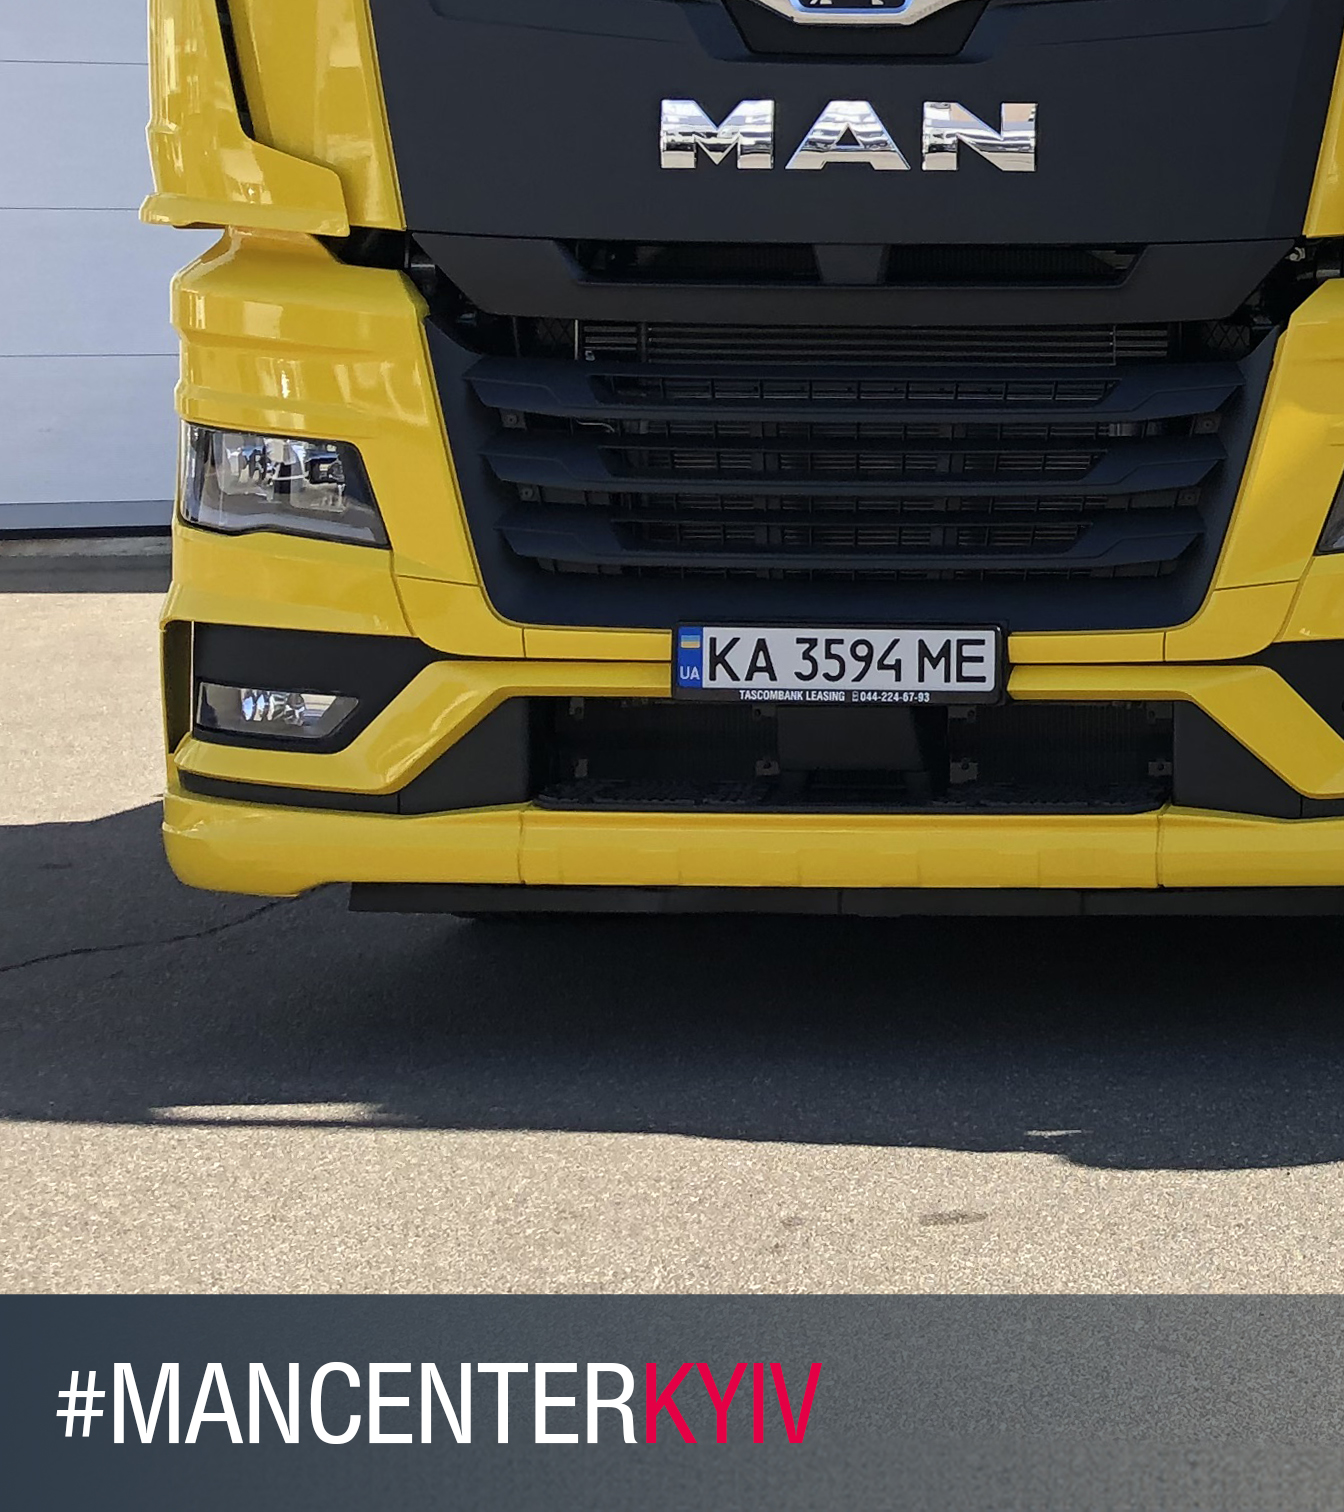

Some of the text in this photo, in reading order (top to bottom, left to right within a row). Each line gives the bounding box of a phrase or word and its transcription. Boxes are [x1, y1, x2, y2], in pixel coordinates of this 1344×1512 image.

[660, 99, 1038, 172] MAN
[680, 666, 700, 680] UA
[708, 637, 987, 683] KA 3594 ME
[739, 690, 803, 701] TASCOMBANK
[805, 691, 845, 701] LEASING
